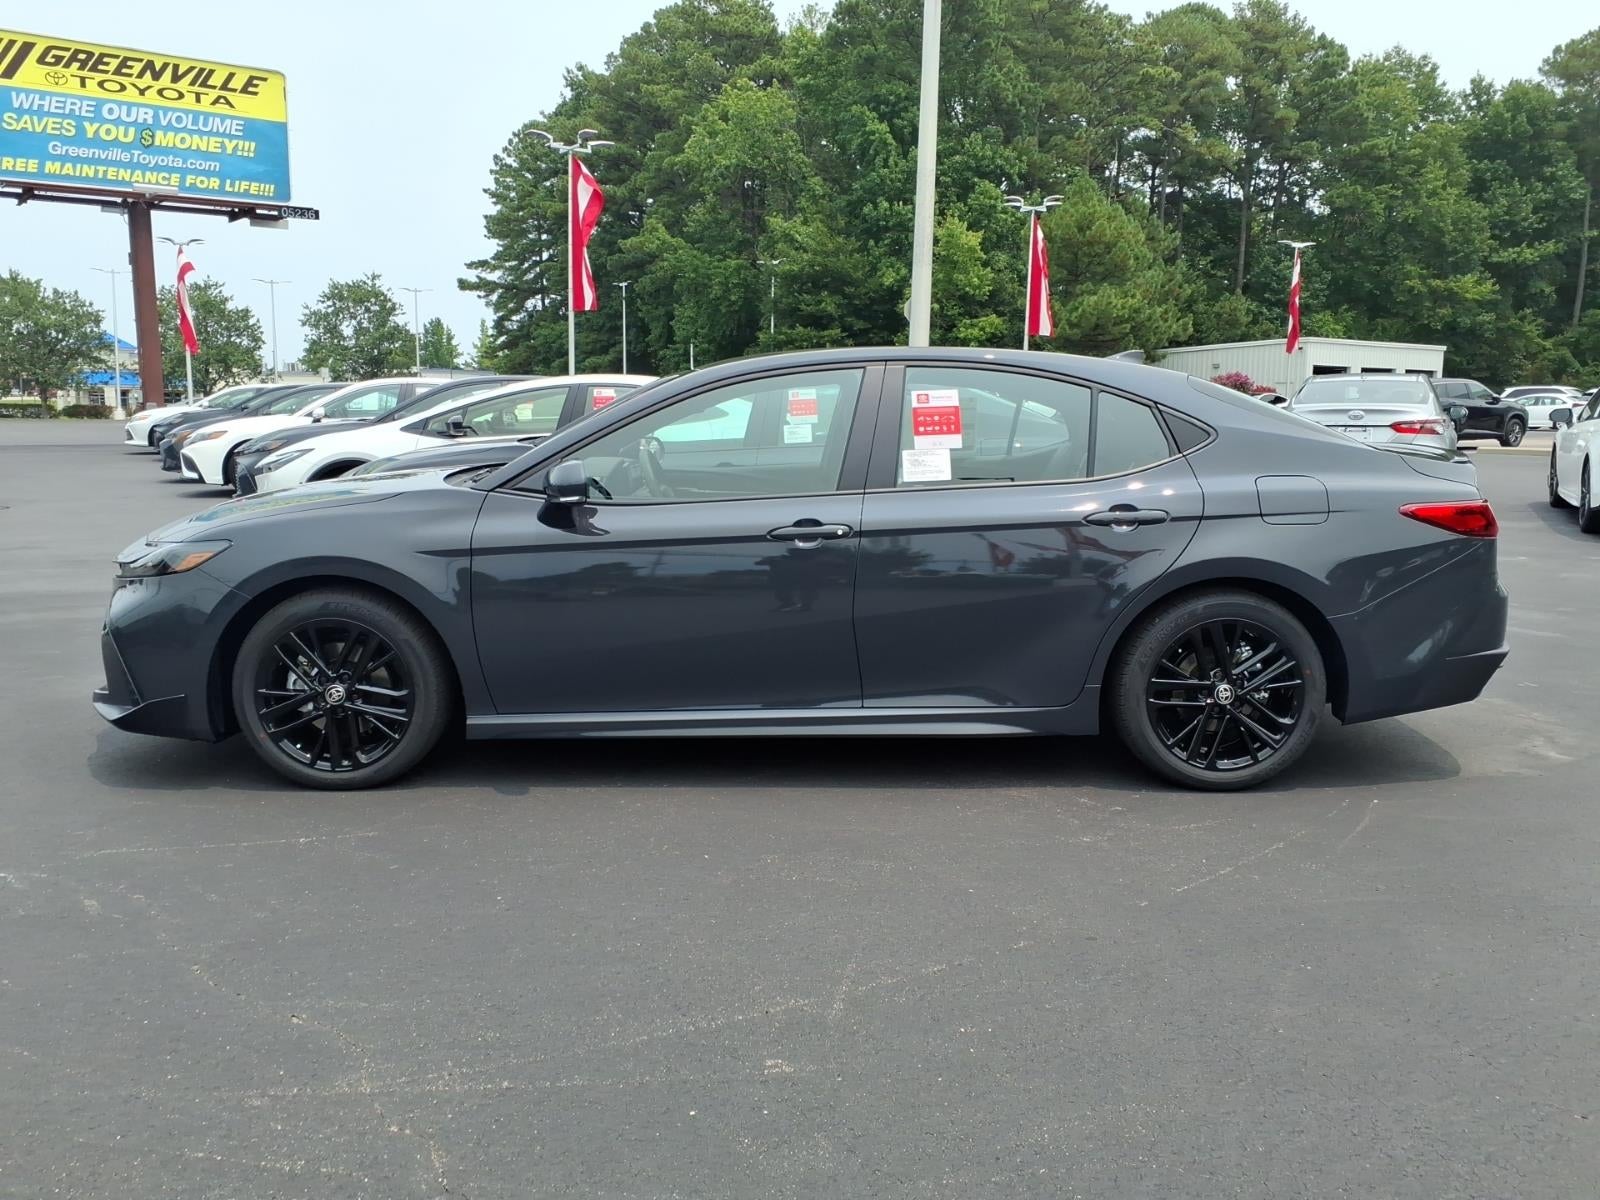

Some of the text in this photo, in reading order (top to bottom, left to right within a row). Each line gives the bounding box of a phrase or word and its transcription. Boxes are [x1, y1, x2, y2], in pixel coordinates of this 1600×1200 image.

[36, 45, 268, 96] GREENVILLE
[70, 74, 236, 109] TOYOTA
[2, 112, 76, 137] SAVES
[83, 121, 136, 143] YOU
[11, 91, 244, 136] WHERE OUR VOLUME
[48, 141, 220, 172] GreenvilleToyota.com
[0, 157, 275, 197] REE MAINTENANCE FOR LIFE!!!
[281, 207, 316, 220] 05236
